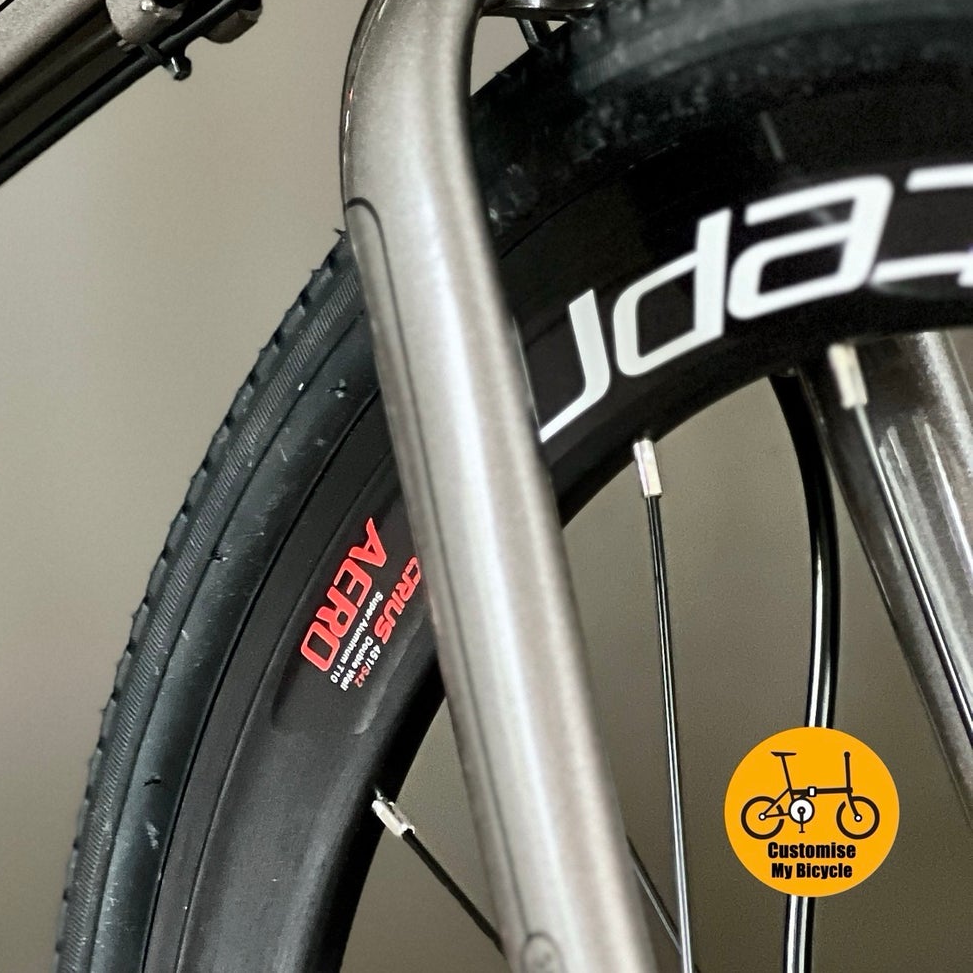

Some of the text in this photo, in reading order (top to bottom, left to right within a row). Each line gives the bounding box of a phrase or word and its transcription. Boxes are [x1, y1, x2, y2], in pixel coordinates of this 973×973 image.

[301, 517, 387, 672] AERO
[330, 591, 384, 683] Super Aluminum T10
[374, 556, 421, 644] CRIUS
[340, 635, 374, 691] Double Wall
